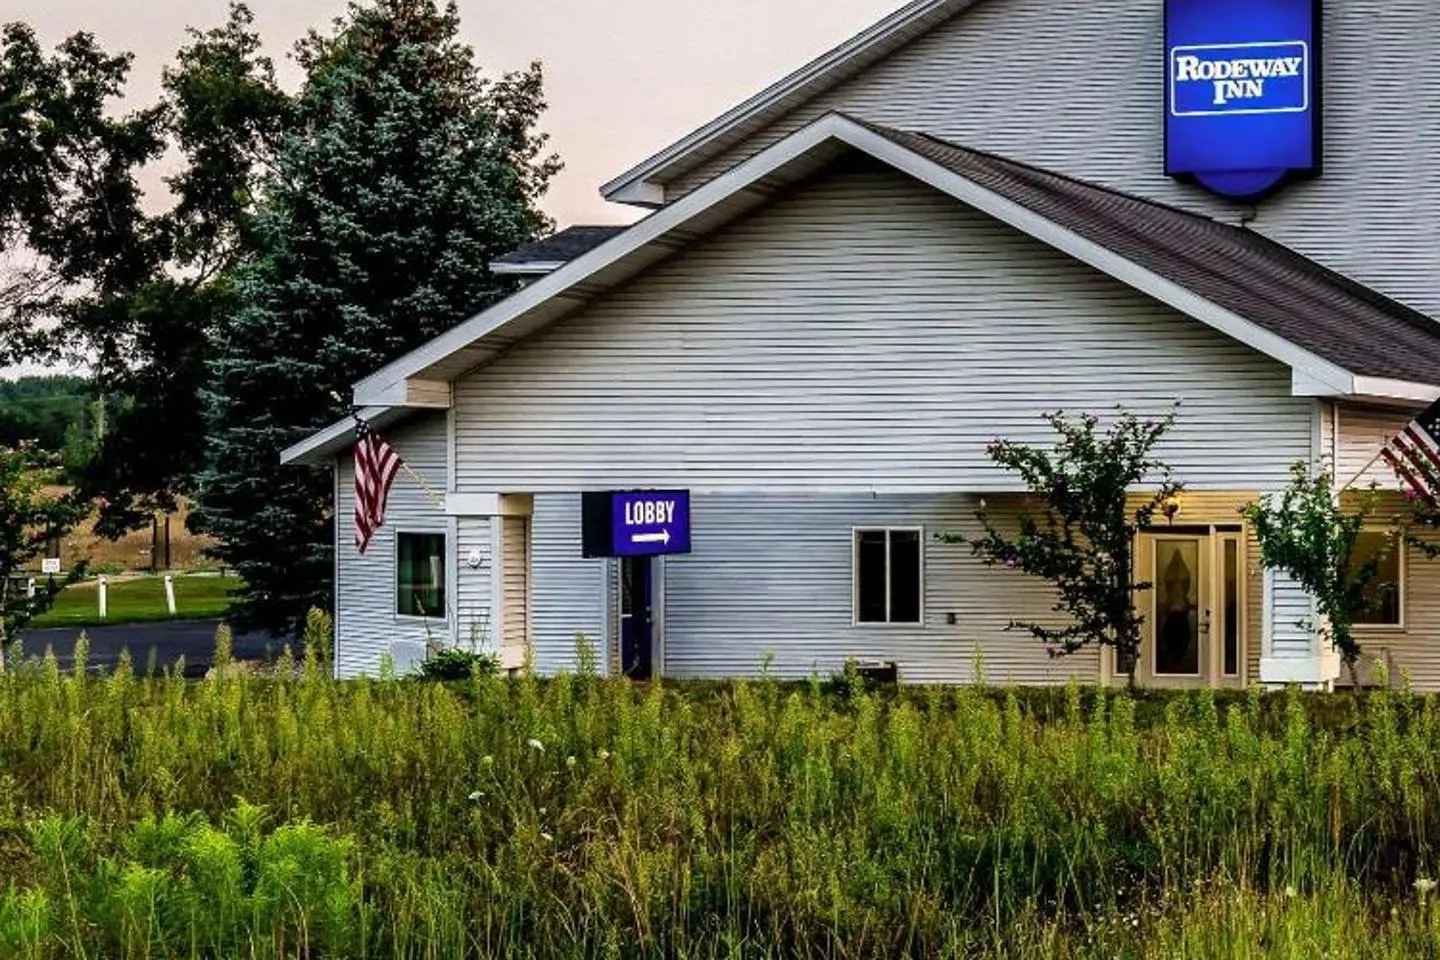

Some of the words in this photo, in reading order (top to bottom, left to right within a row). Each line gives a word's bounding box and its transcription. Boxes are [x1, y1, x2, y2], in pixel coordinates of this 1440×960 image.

[1176, 55, 1302, 81] RODEWAY
[1213, 79, 1264, 104] INN
[625, 500, 675, 525] LOBBY
